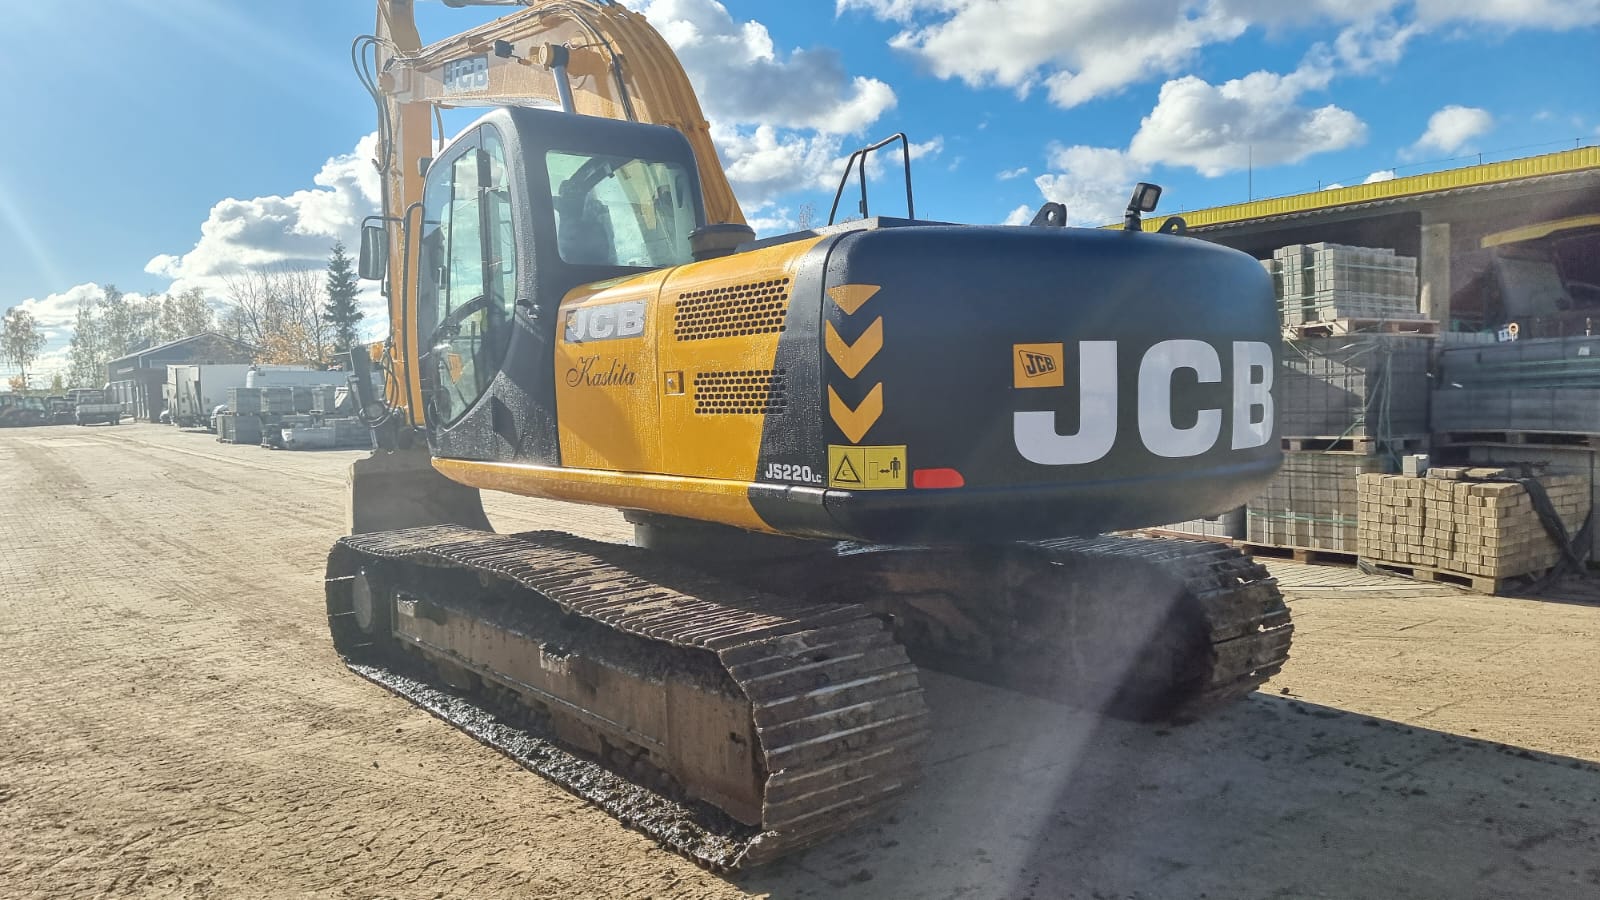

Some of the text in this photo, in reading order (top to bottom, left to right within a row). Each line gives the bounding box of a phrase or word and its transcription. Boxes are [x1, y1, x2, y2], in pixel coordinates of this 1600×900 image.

[445, 57, 487, 89] JCB
[566, 301, 645, 341] JCB
[1025, 353, 1054, 375] JCB
[1013, 339, 1274, 465] JCB
